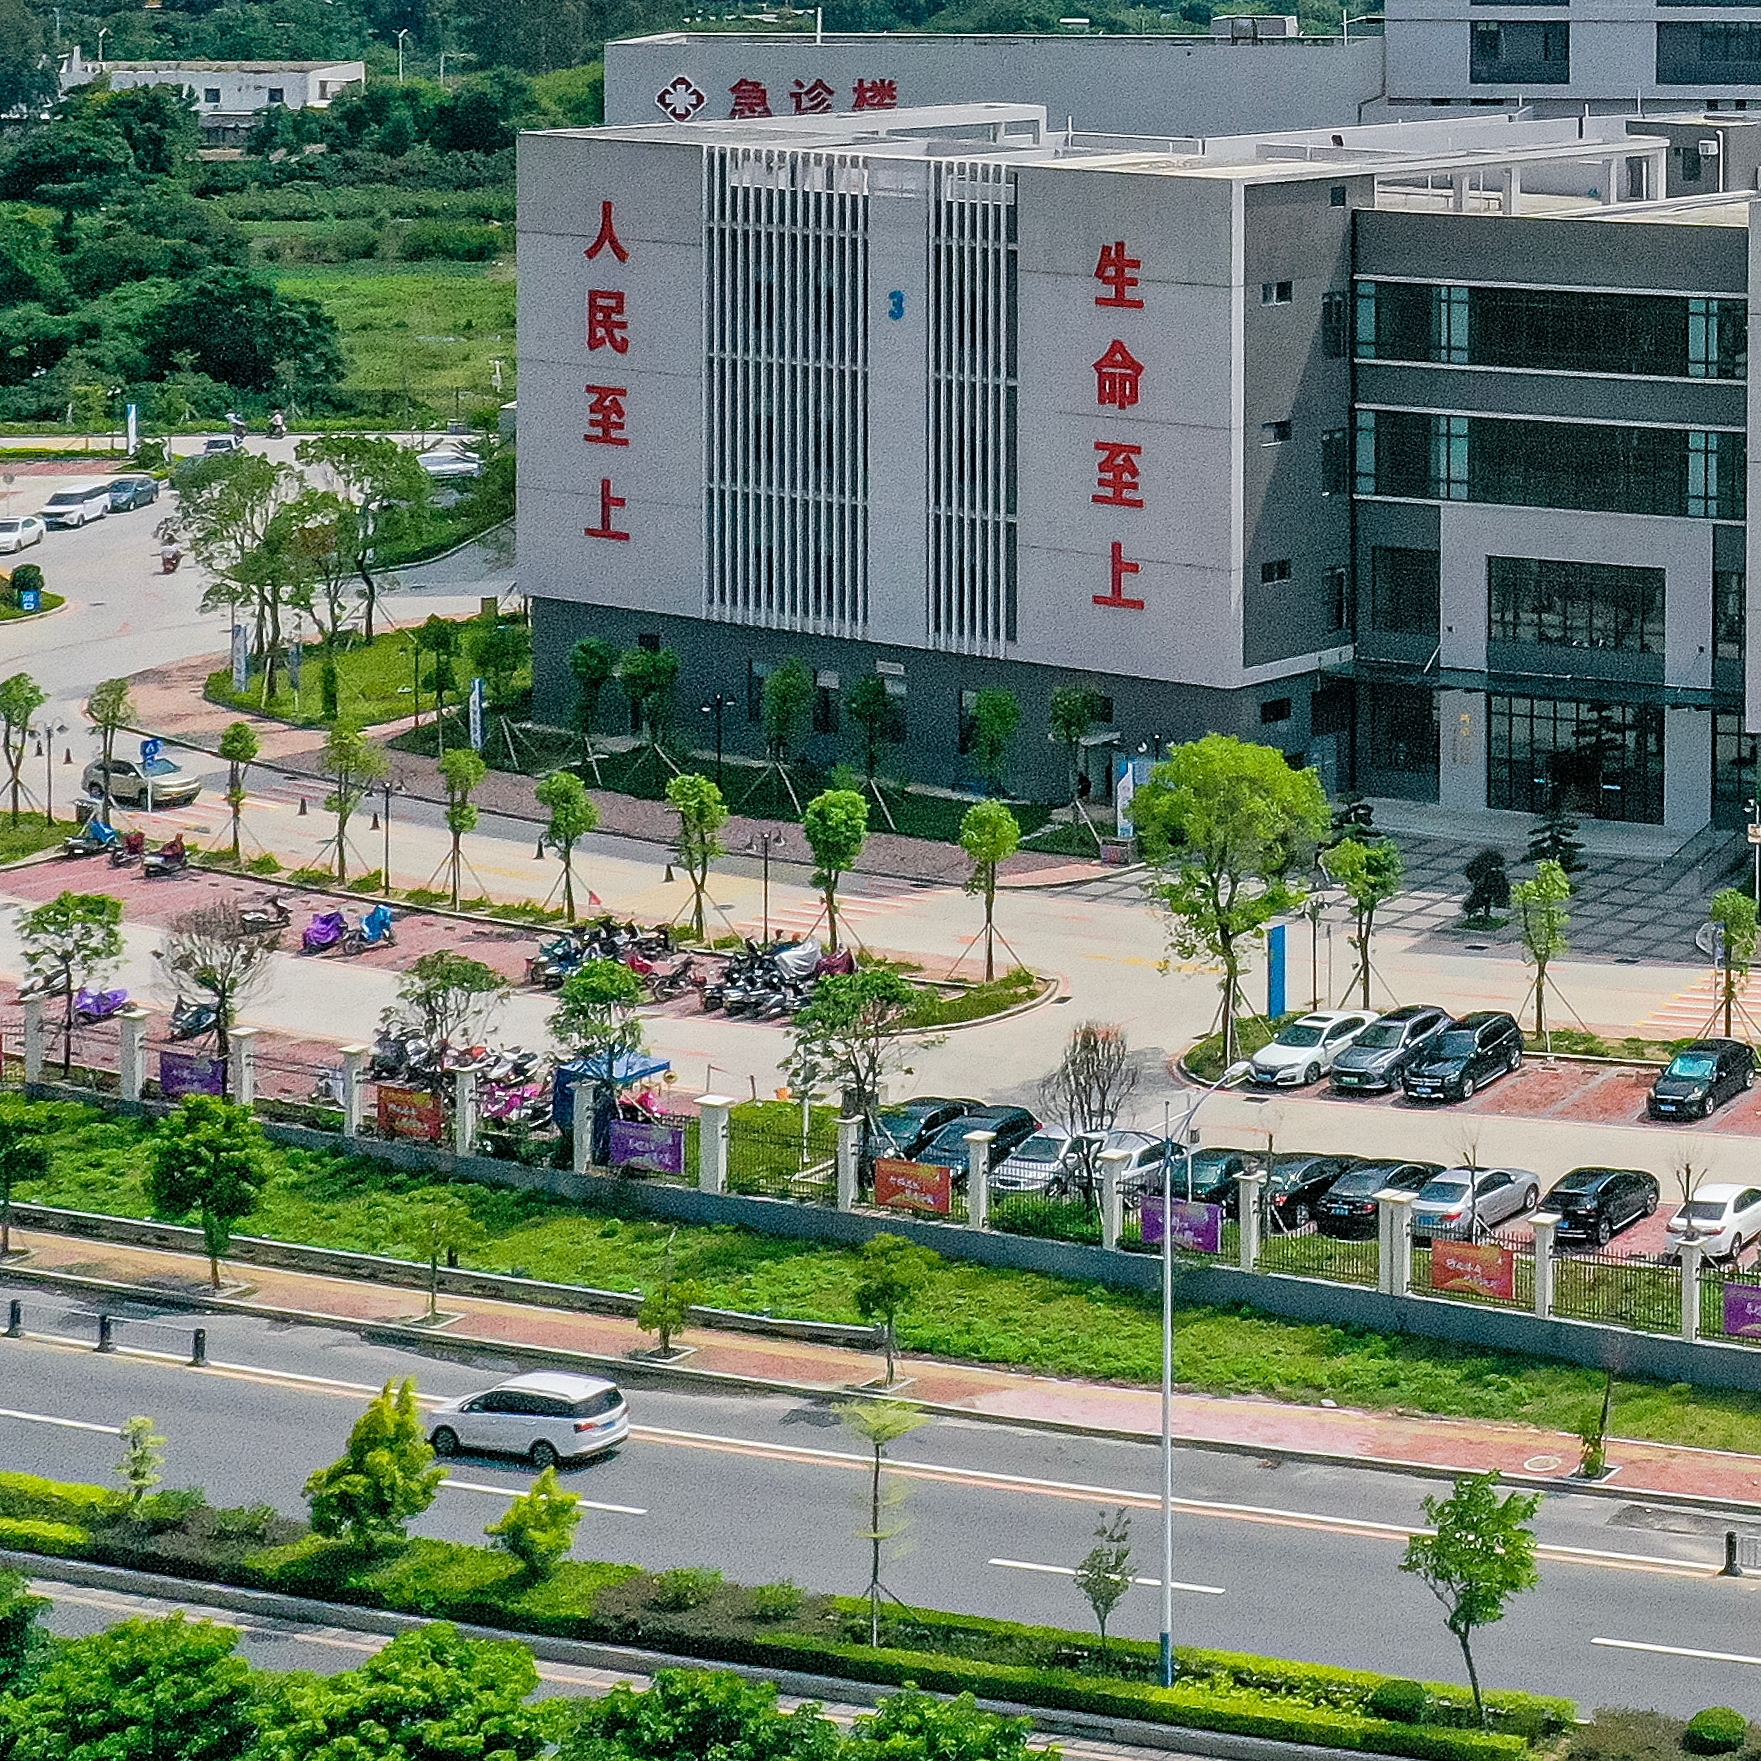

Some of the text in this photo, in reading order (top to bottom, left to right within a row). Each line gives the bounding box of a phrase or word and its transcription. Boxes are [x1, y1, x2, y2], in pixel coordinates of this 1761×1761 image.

[728, 78, 897, 117] 急诊楼
[584, 201, 631, 542] 人民至上
[888, 290, 906, 321] 3
[1091, 241, 1145, 611] 生命至上
